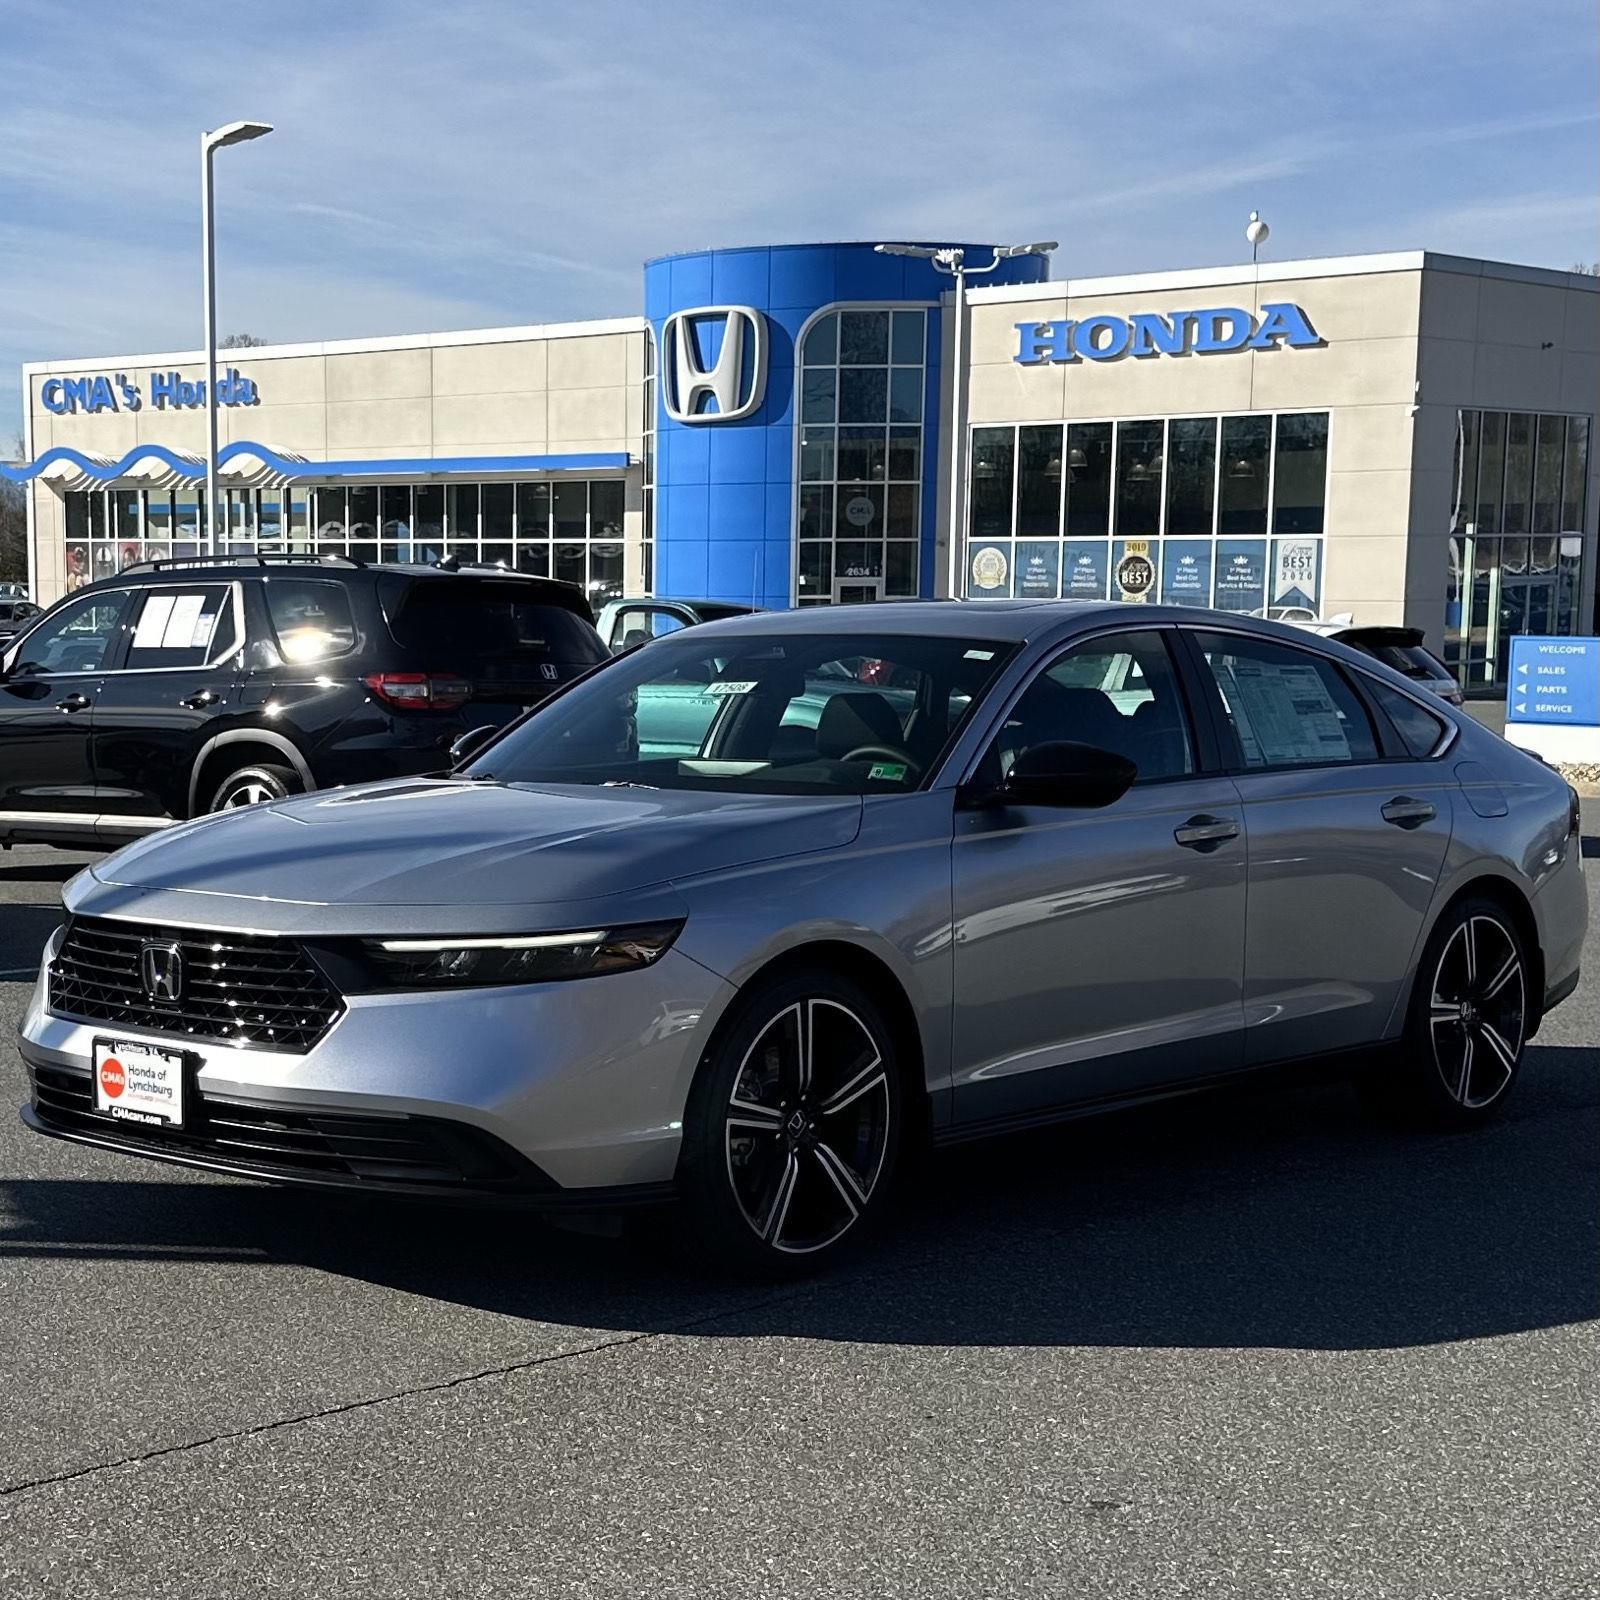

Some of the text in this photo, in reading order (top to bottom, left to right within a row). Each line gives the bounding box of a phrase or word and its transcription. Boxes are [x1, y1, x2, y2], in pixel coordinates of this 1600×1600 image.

[1013, 303, 1321, 364] HONDA
[42, 368, 258, 415] CMA's Honda
[1126, 542, 1147, 552] 2019
[1282, 556, 1312, 569] BEST
[1121, 571, 1149, 584] BEST
[1282, 571, 1313, 581] 2020
[1538, 645, 1587, 655] WELCOME
[1537, 666, 1567, 675] SALES
[1536, 685, 1568, 694] PARTS
[1535, 704, 1573, 713] SERVICE
[128, 1064, 167, 1080] Honda of
[128, 1078, 173, 1099] Lynchburg
[111, 1106, 162, 1126] CMAcars.com
